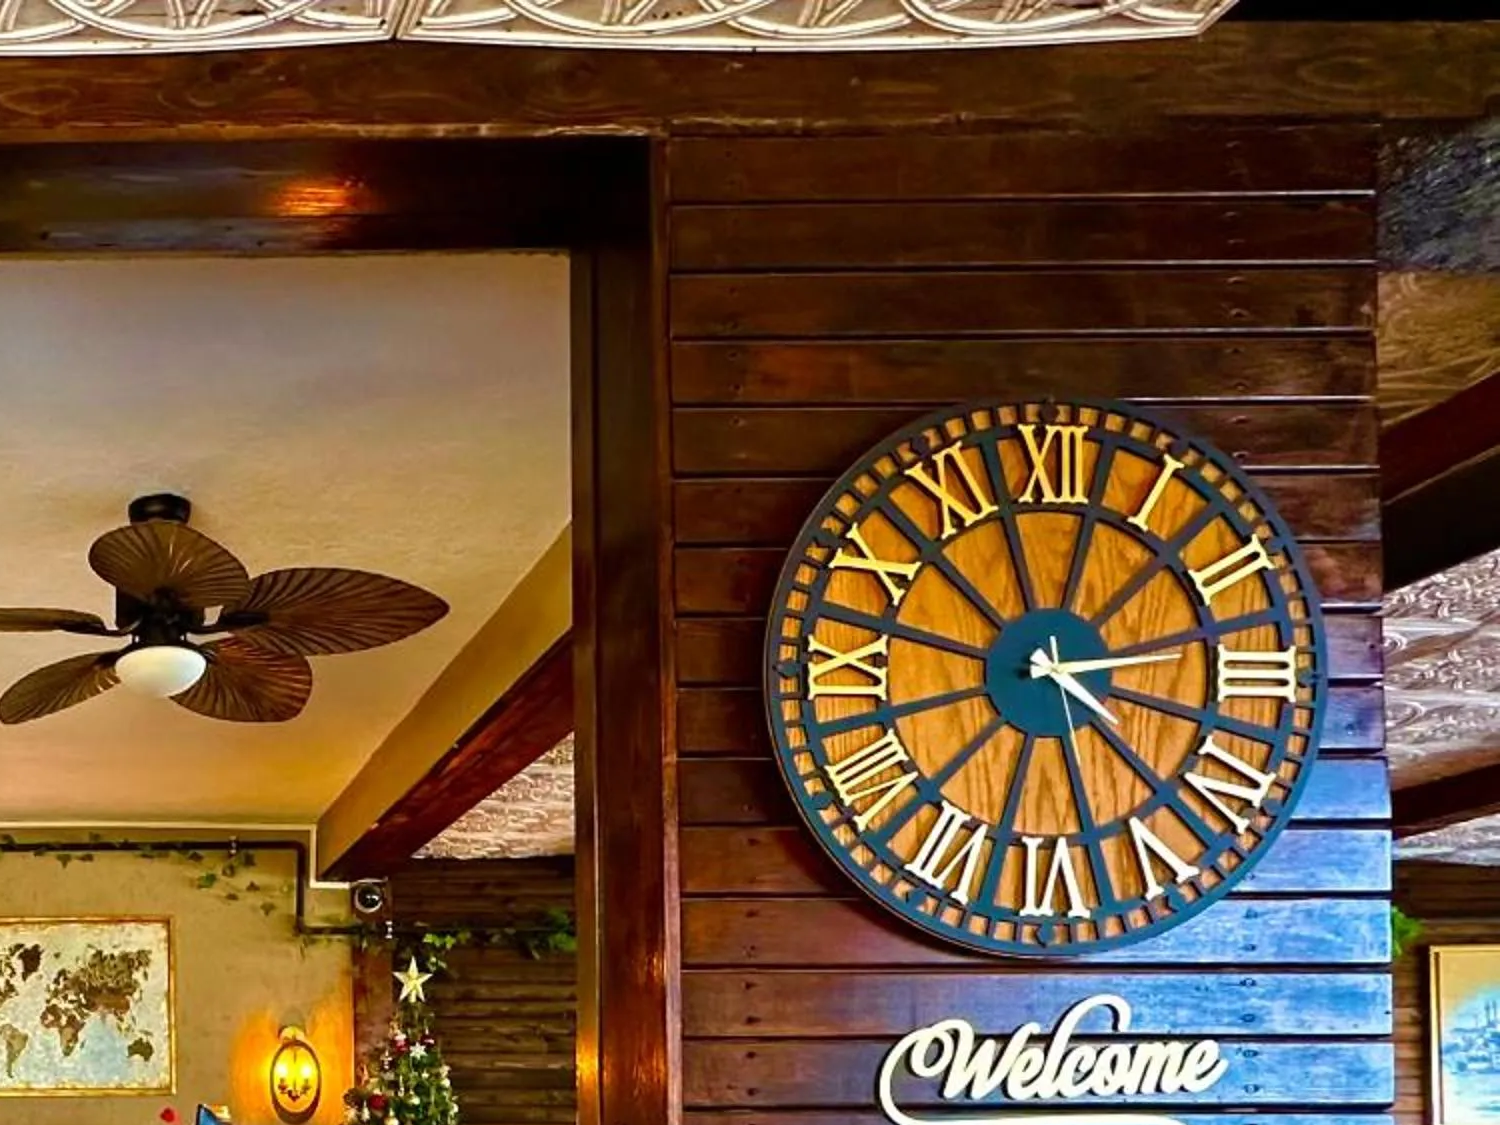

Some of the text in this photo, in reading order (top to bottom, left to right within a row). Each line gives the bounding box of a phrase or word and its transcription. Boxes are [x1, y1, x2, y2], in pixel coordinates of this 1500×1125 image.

[904, 441, 998, 539] XI
[1017, 424, 1088, 504] XII
[1127, 453, 1184, 532] I
[828, 523, 922, 606] X
[1187, 533, 1275, 607] II
[807, 634, 888, 701] IX
[1216, 644, 1296, 702] III
[825, 729, 919, 831] VIII
[1184, 736, 1277, 834] IV
[905, 800, 989, 904] VII
[1019, 836, 1090, 918] VI
[1128, 816, 1199, 900] V
